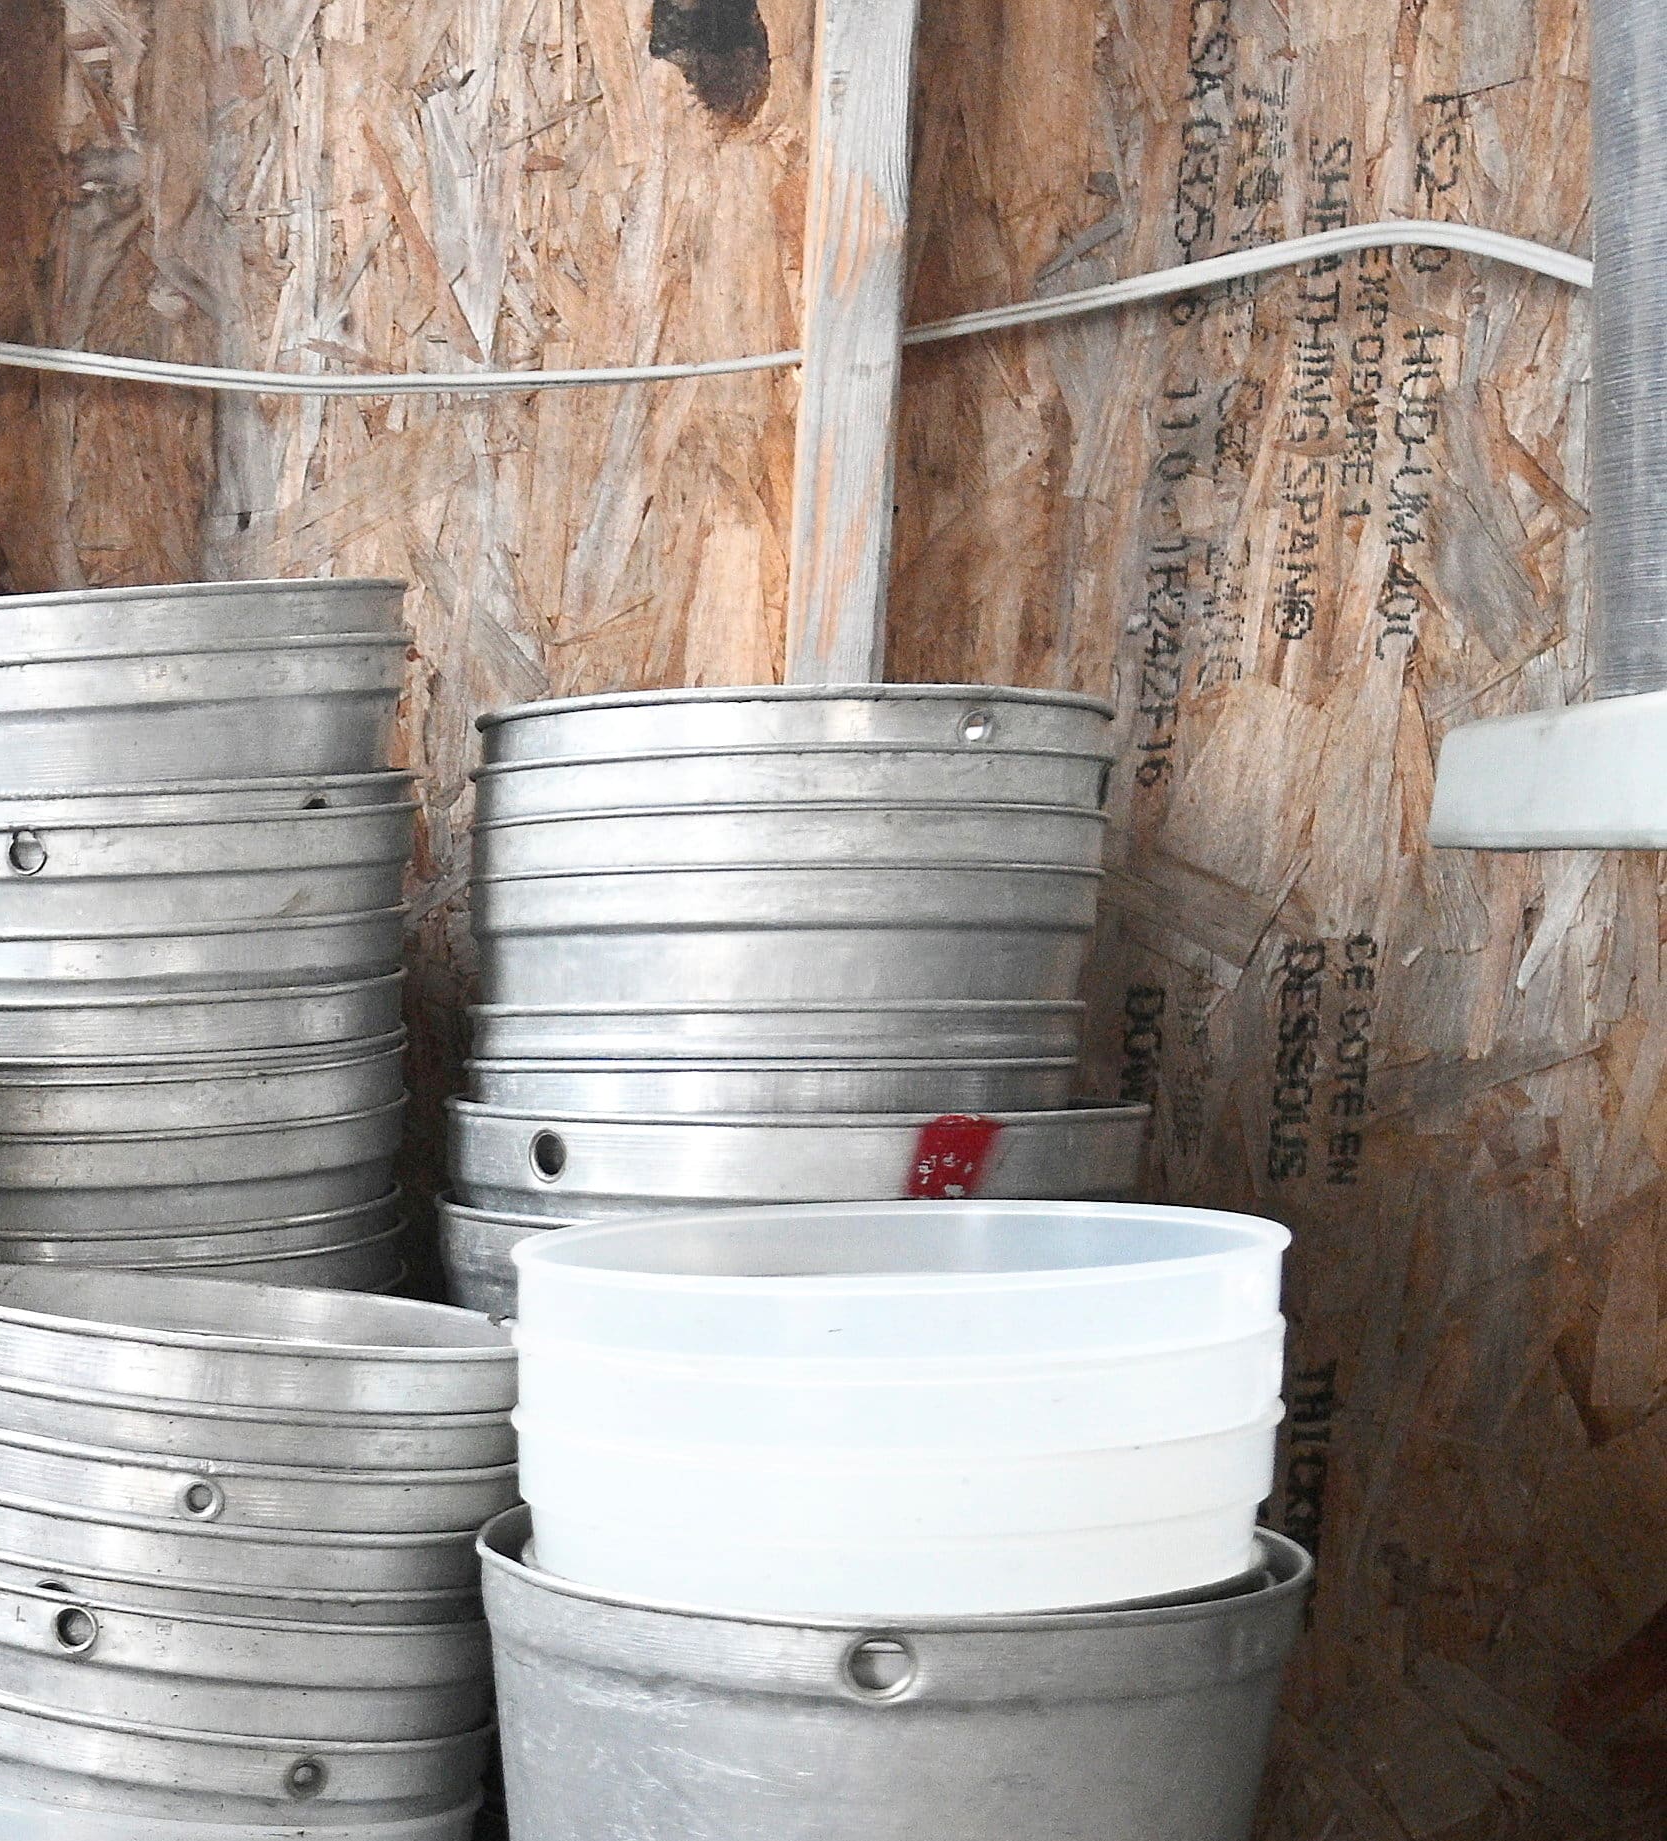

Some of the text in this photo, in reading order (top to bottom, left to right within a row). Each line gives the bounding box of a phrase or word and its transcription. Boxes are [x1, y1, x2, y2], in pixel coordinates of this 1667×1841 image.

[1344, 929, 1377, 990] CE
[1268, 943, 1325, 1184] DESSOUS
[1326, 1132, 1361, 1185] EN
